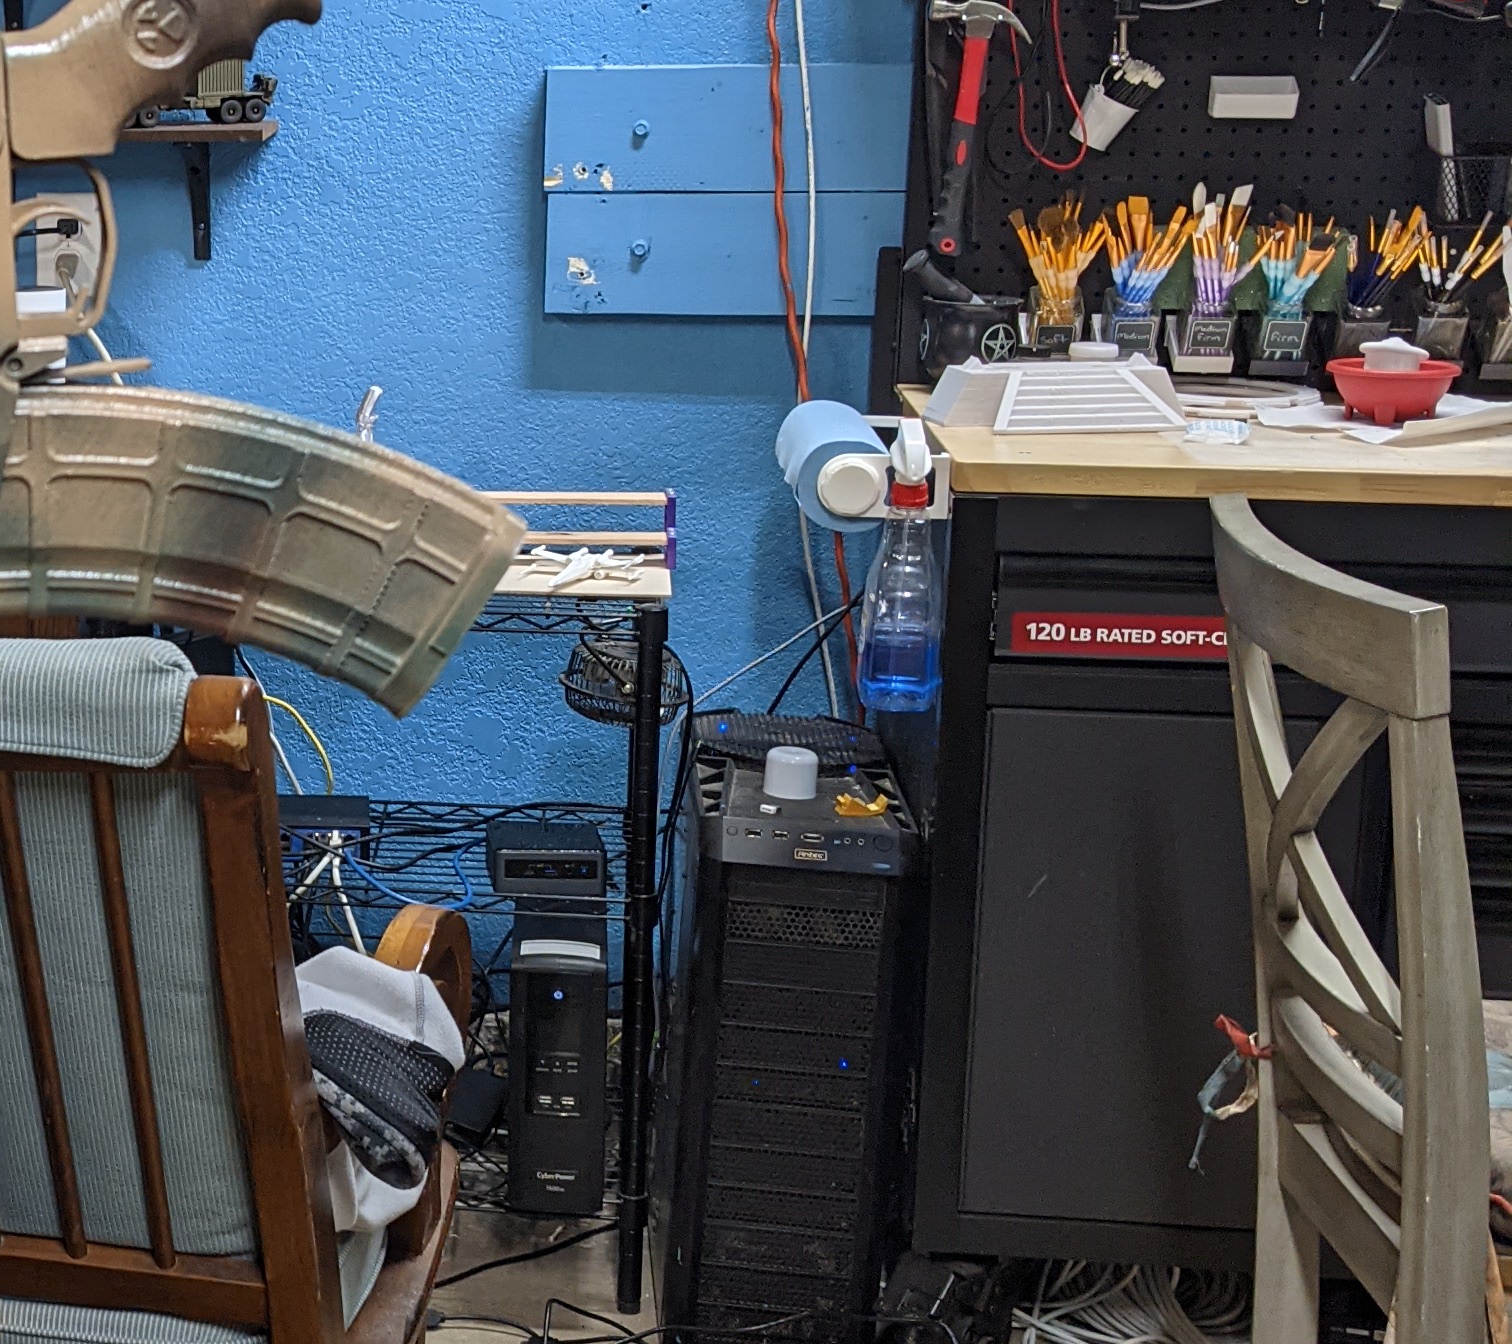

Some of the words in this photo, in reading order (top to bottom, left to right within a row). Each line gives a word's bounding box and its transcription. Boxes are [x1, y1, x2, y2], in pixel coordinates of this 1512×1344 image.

[1025, 622, 1066, 642] 120
[1070, 627, 1092, 643] LB
[1096, 628, 1157, 645] RATED
